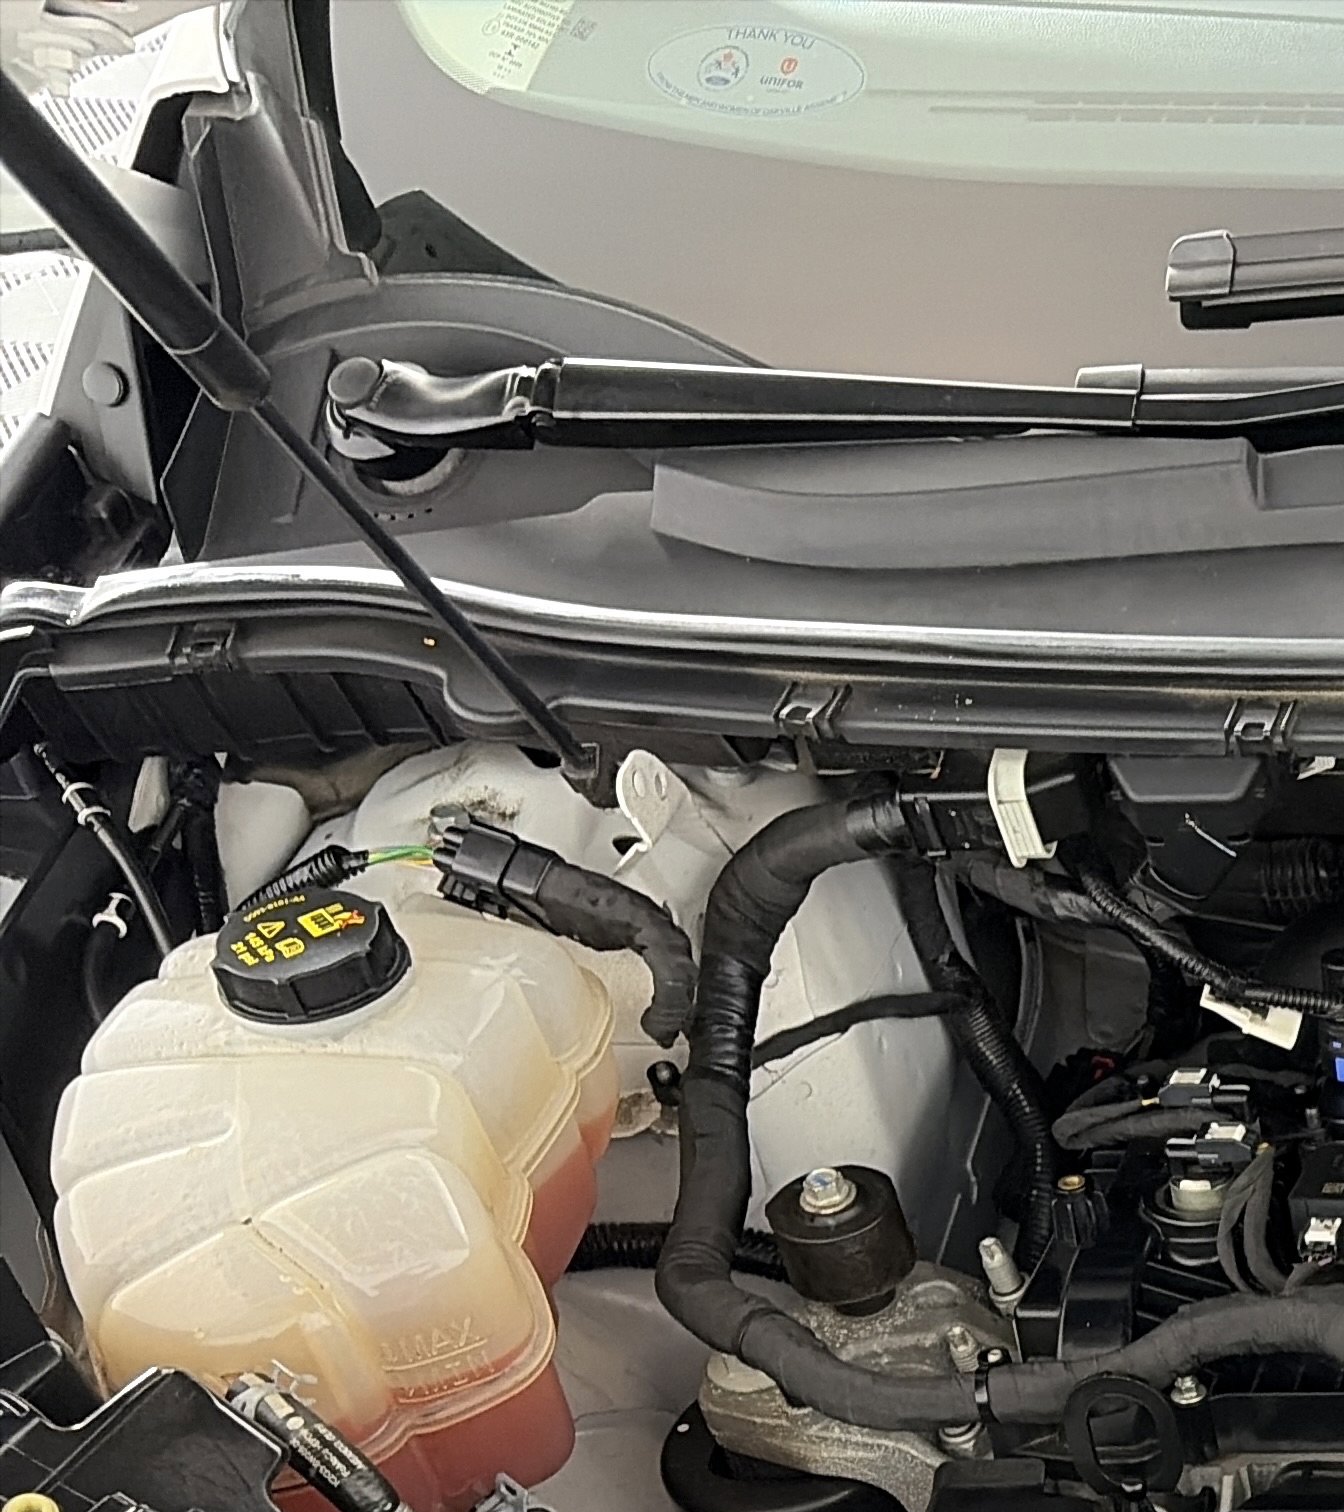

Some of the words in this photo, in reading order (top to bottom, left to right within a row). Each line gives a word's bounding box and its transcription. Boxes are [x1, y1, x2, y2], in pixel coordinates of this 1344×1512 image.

[728, 28, 778, 41] THANK
[783, 30, 816, 50] YOU
[760, 75, 803, 89] UNIFOR
